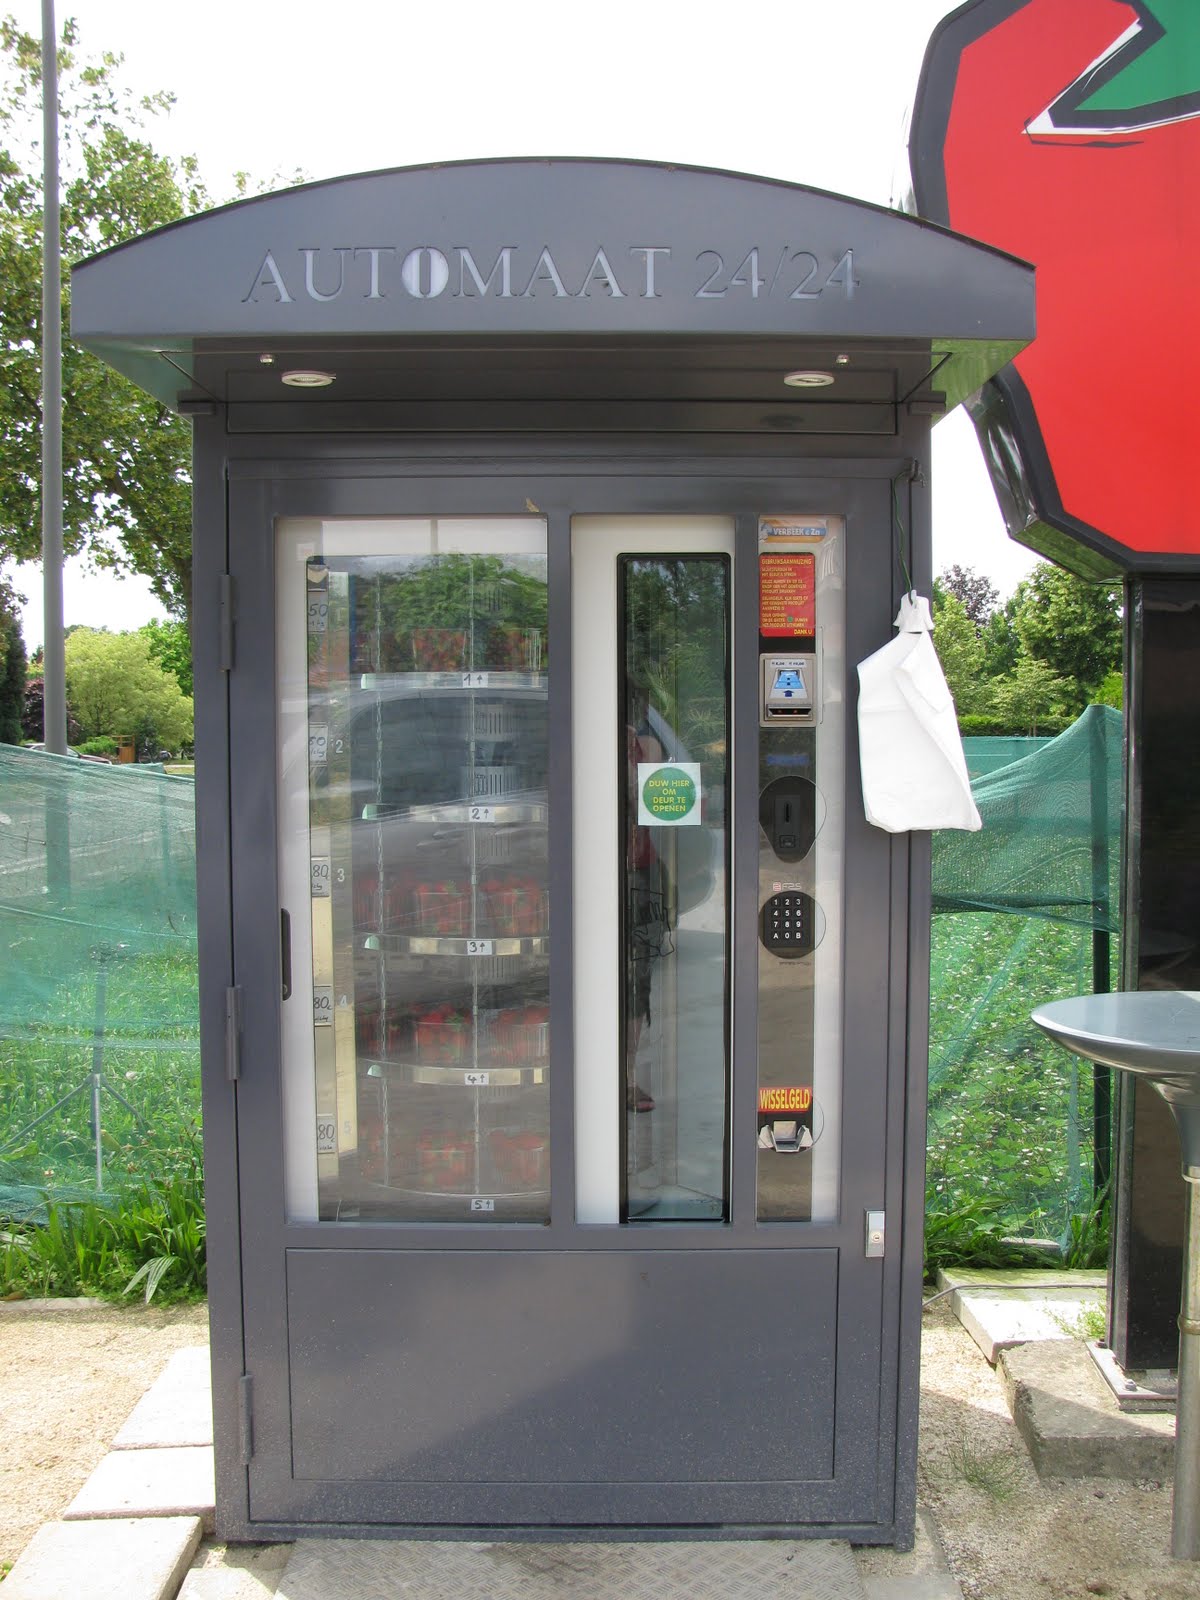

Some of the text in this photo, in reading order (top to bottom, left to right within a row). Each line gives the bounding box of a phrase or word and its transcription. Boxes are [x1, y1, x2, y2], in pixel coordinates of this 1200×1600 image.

[241, 246, 860, 303] AUTOMAAT 24/24
[336, 740, 344, 754] 2
[472, 808, 480, 819] 2
[337, 868, 345, 882] 3
[470, 942, 477, 952] 3
[760, 1088, 810, 1110] WISSELGELD
